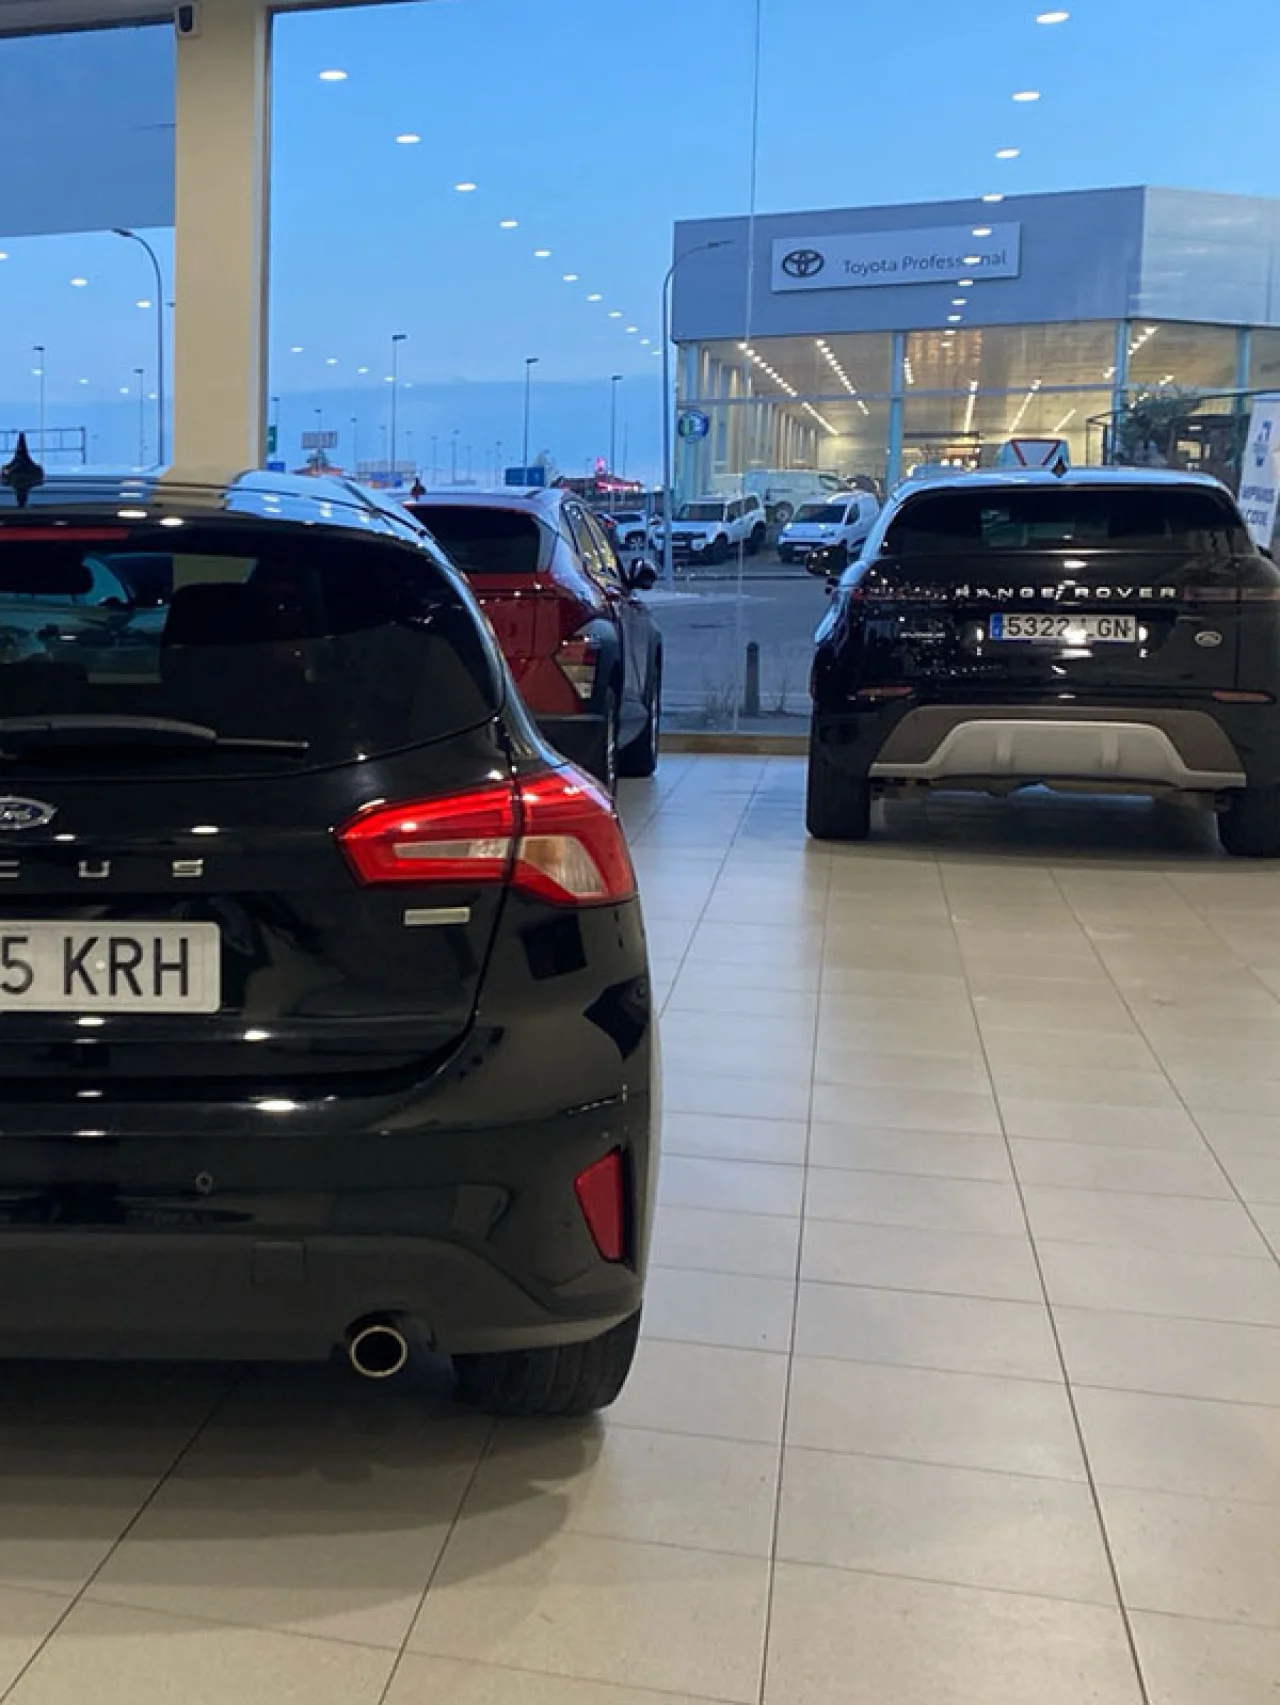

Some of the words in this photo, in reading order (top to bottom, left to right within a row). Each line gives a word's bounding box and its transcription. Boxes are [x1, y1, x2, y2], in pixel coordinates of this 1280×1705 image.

[844, 258, 897, 276] Toyota
[1073, 586, 1177, 599] ROVER
[62, 936, 189, 997] KRH
